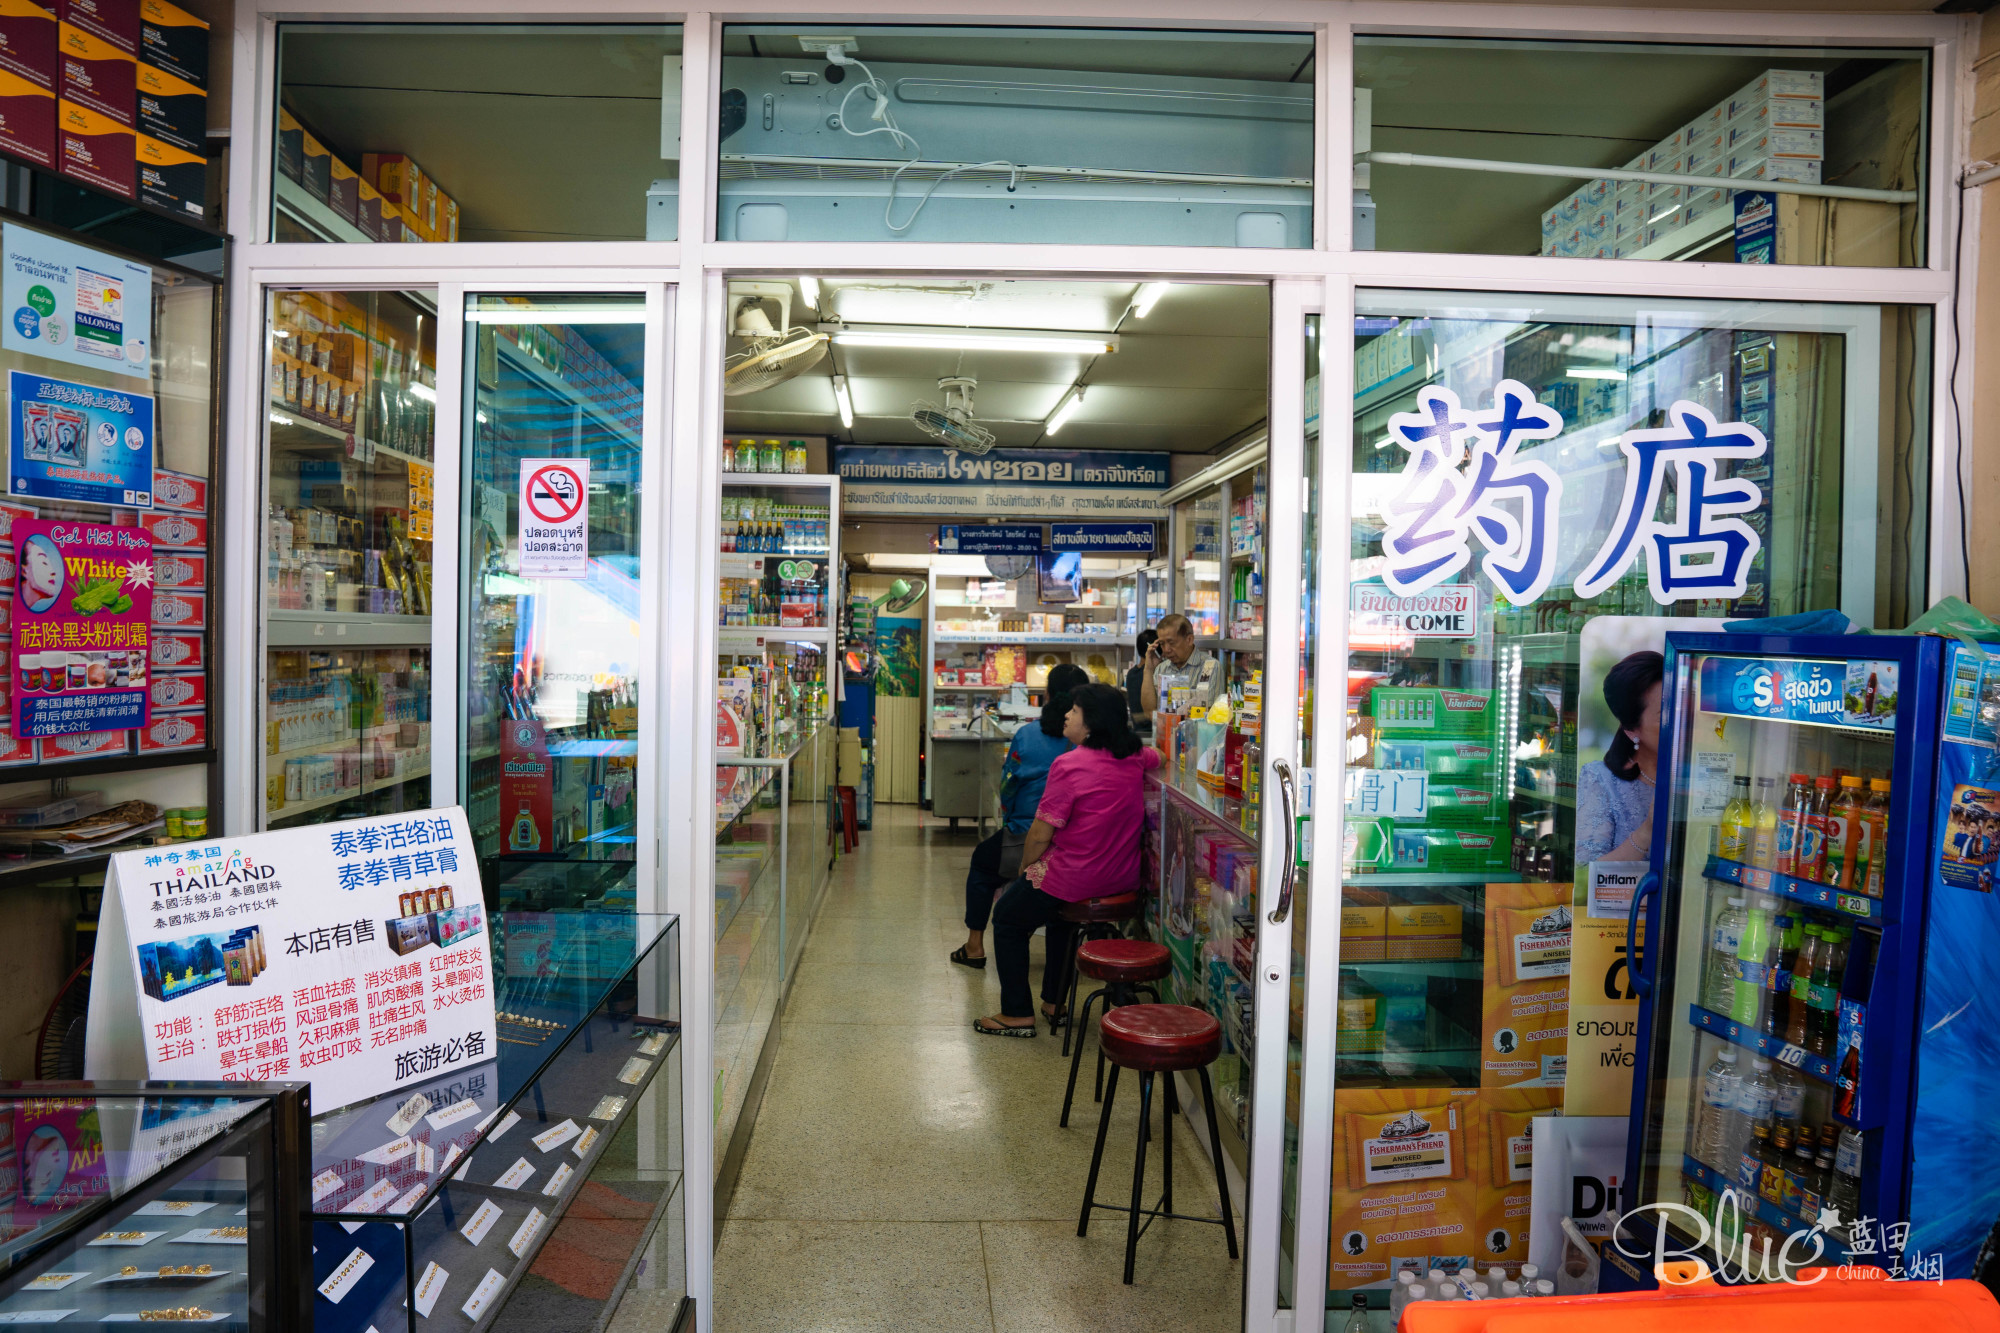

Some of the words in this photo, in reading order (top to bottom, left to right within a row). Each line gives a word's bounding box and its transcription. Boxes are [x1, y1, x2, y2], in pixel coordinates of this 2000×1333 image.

[77, 314, 121, 332] SALONPAS
[840, 459, 946, 480] ยาถ่ายพยาธิสัตว์
[943, 449, 1072, 482] ไพซอย
[1084, 464, 1155, 484] ตราจิ้งหรีด
[1386, 385, 1762, 600] 药店
[51, 525, 82, 548] Gel
[525, 522, 583, 542] ปลอดบุหรี่
[1053, 527, 1152, 547] สถานที่ขายยาแผนปัจจุบัน
[525, 541, 583, 552] ปอดสะอาด
[64, 557, 128, 580] White
[19, 621, 148, 649] 祛除黑头粉刺霜
[1733, 671, 1784, 712] est
[1785, 667, 1832, 706] สุดขั้ว
[35, 693, 143, 710] 泰国最畅销的粉刺霜
[1448, 698, 1484, 709] โป๊ยเซียน
[1770, 706, 1784, 714] COLA
[33, 705, 139, 723] 用后使皮肤清新润滑
[32, 721, 91, 736] 价钱大众化
[1459, 751, 1488, 759] โป๊ยเซียน
[1460, 794, 1488, 803] โป๊ยเซียน
[330, 816, 454, 858] 泰拳活络油
[1462, 838, 1491, 847] โป๊ยเซียน
[144, 846, 222, 868] 神奇泰国
[176, 853, 253, 877] amazing
[337, 846, 458, 891] 泰拳青草膏
[150, 865, 275, 897] THAILAND
[1597, 874, 1636, 885] Difflam
[150, 890, 222, 912] 泰國活絡油
[229, 880, 283, 898] 泰國國粹
[1850, 899, 1860, 910] 20
[153, 898, 279, 930] 泰國旅游局合作伙伴
[284, 918, 375, 958] 本店有售
[1519, 938, 1567, 951] FISHERMAN'S
[214, 995, 284, 1028] 舒筋活络
[293, 977, 356, 1007] 活血祛瘀
[364, 961, 422, 989] 消炎镇痛
[429, 946, 483, 973] 红肿发炎
[217, 1016, 286, 1048] 跌打损伤
[296, 997, 359, 1028] 风湿骨痛
[367, 981, 424, 1009] 肌肉酸痛
[431, 965, 484, 992] 头晕胸闷
[220, 1036, 289, 1070] 晕车晕船
[298, 1017, 361, 1049] 久积麻痹
[369, 1000, 426, 1029] 肚痛生风
[433, 984, 485, 1011] 水火烫伤
[300, 1037, 362, 1069] 蚊虫叮咬
[371, 1019, 427, 1049] 无名肿痛
[395, 1031, 486, 1081] 旅游必备
[1485, 1061, 1517, 1069] FISHERMAN'S
[1517, 1061, 1537, 1069] FRIEND
[1783, 1046, 1801, 1064] 10
[1369, 1142, 1416, 1155] FISHERMAN'S
[1416, 1140, 1444, 1151] FRIEND
[1392, 1154, 1422, 1163] ANISEED
[1763, 1175, 1775, 1188] M
[1417, 1188, 1446, 1201] เฟรนด์
[1736, 1191, 1754, 1212] 10
[1375, 1224, 1464, 1244] ลดอาการระคายคอ
[1334, 1263, 1366, 1271] FISHERMAN'S
[1366, 1263, 1387, 1271] FRIEND
